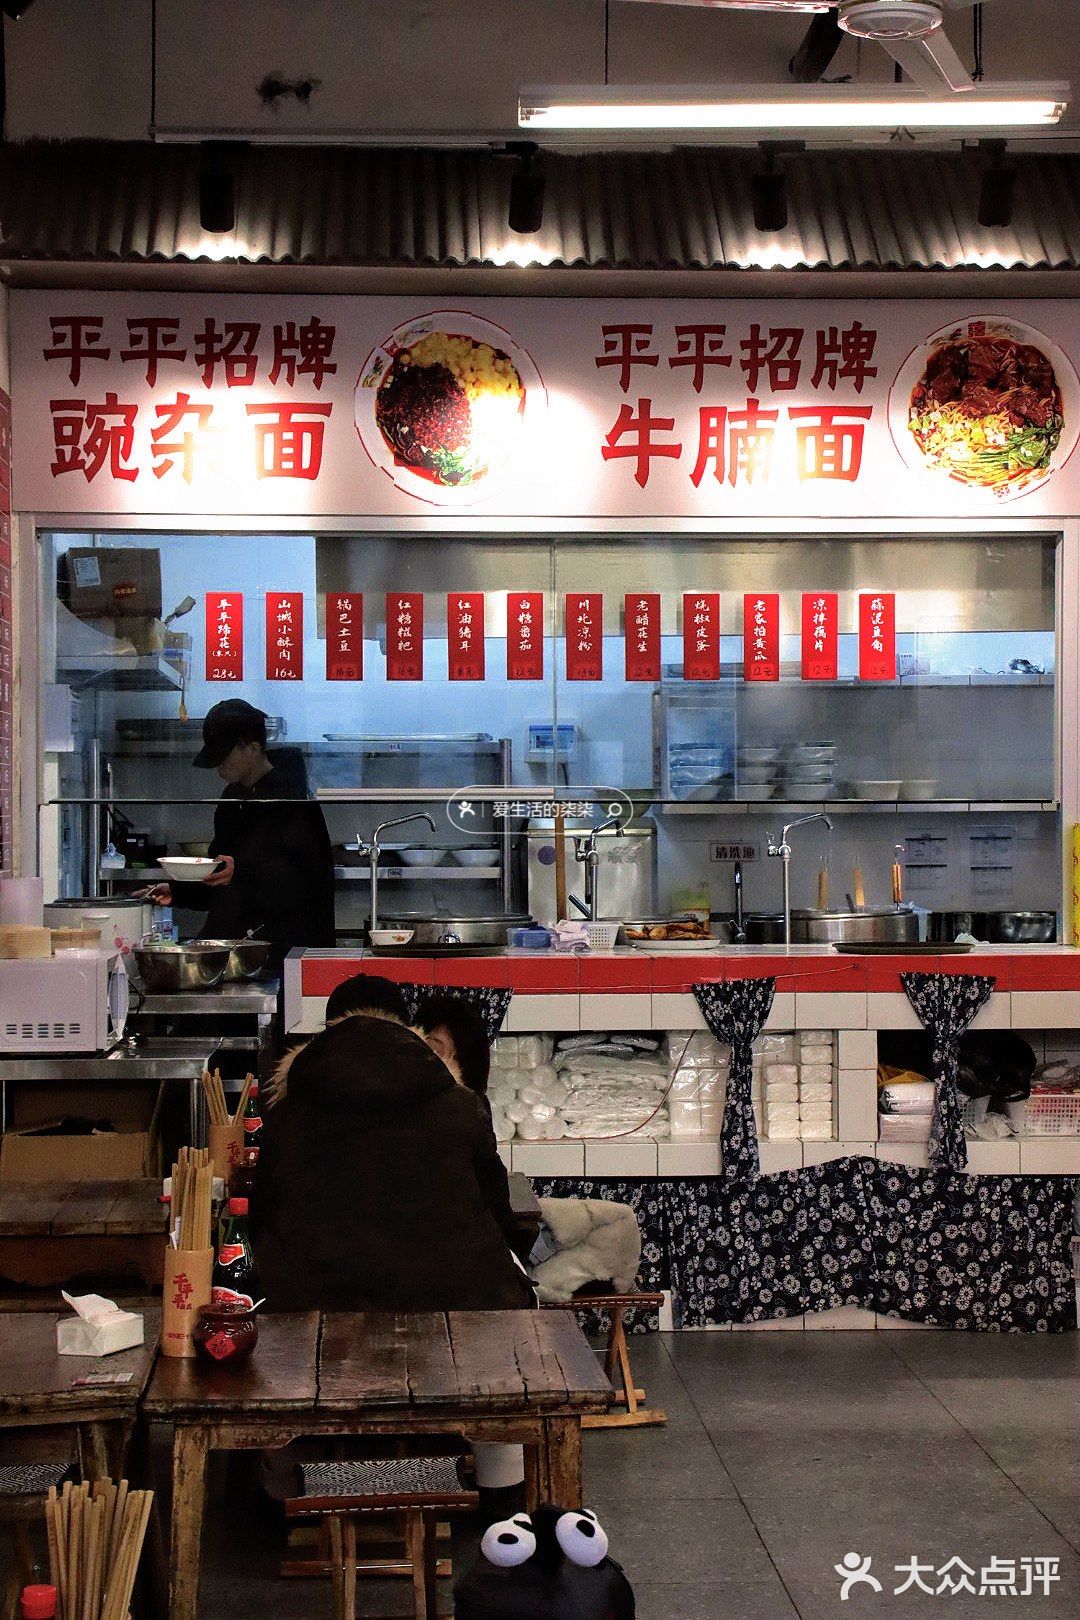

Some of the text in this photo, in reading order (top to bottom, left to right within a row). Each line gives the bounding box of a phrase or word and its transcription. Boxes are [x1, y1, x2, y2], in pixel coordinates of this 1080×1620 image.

[43, 316, 337, 389] 平平招牌
[595, 321, 879, 393] 平平招牌
[50, 393, 334, 485] 豌杂面
[601, 398, 874, 489] 牛腩面
[216, 598, 233, 648] 平平蹄花
[276, 599, 295, 662] 山城小酥肉
[336, 598, 352, 653] 锅巴土豆
[396, 599, 414, 652] 红糖糍粑
[457, 599, 473, 652] 红油猪耳
[517, 599, 533, 651] 白糖番茄
[577, 598, 593, 652] 川北凉粉
[635, 599, 649, 652] 老醋花生
[693, 598, 711, 652] 烧椒皮蛋
[753, 599, 768, 661] 老家拍黄瓜
[813, 598, 827, 653] 凉拌藕片
[870, 598, 885, 653] 蒜泥豆角
[212, 668, 237, 679] 28元
[275, 667, 297, 678] 16元
